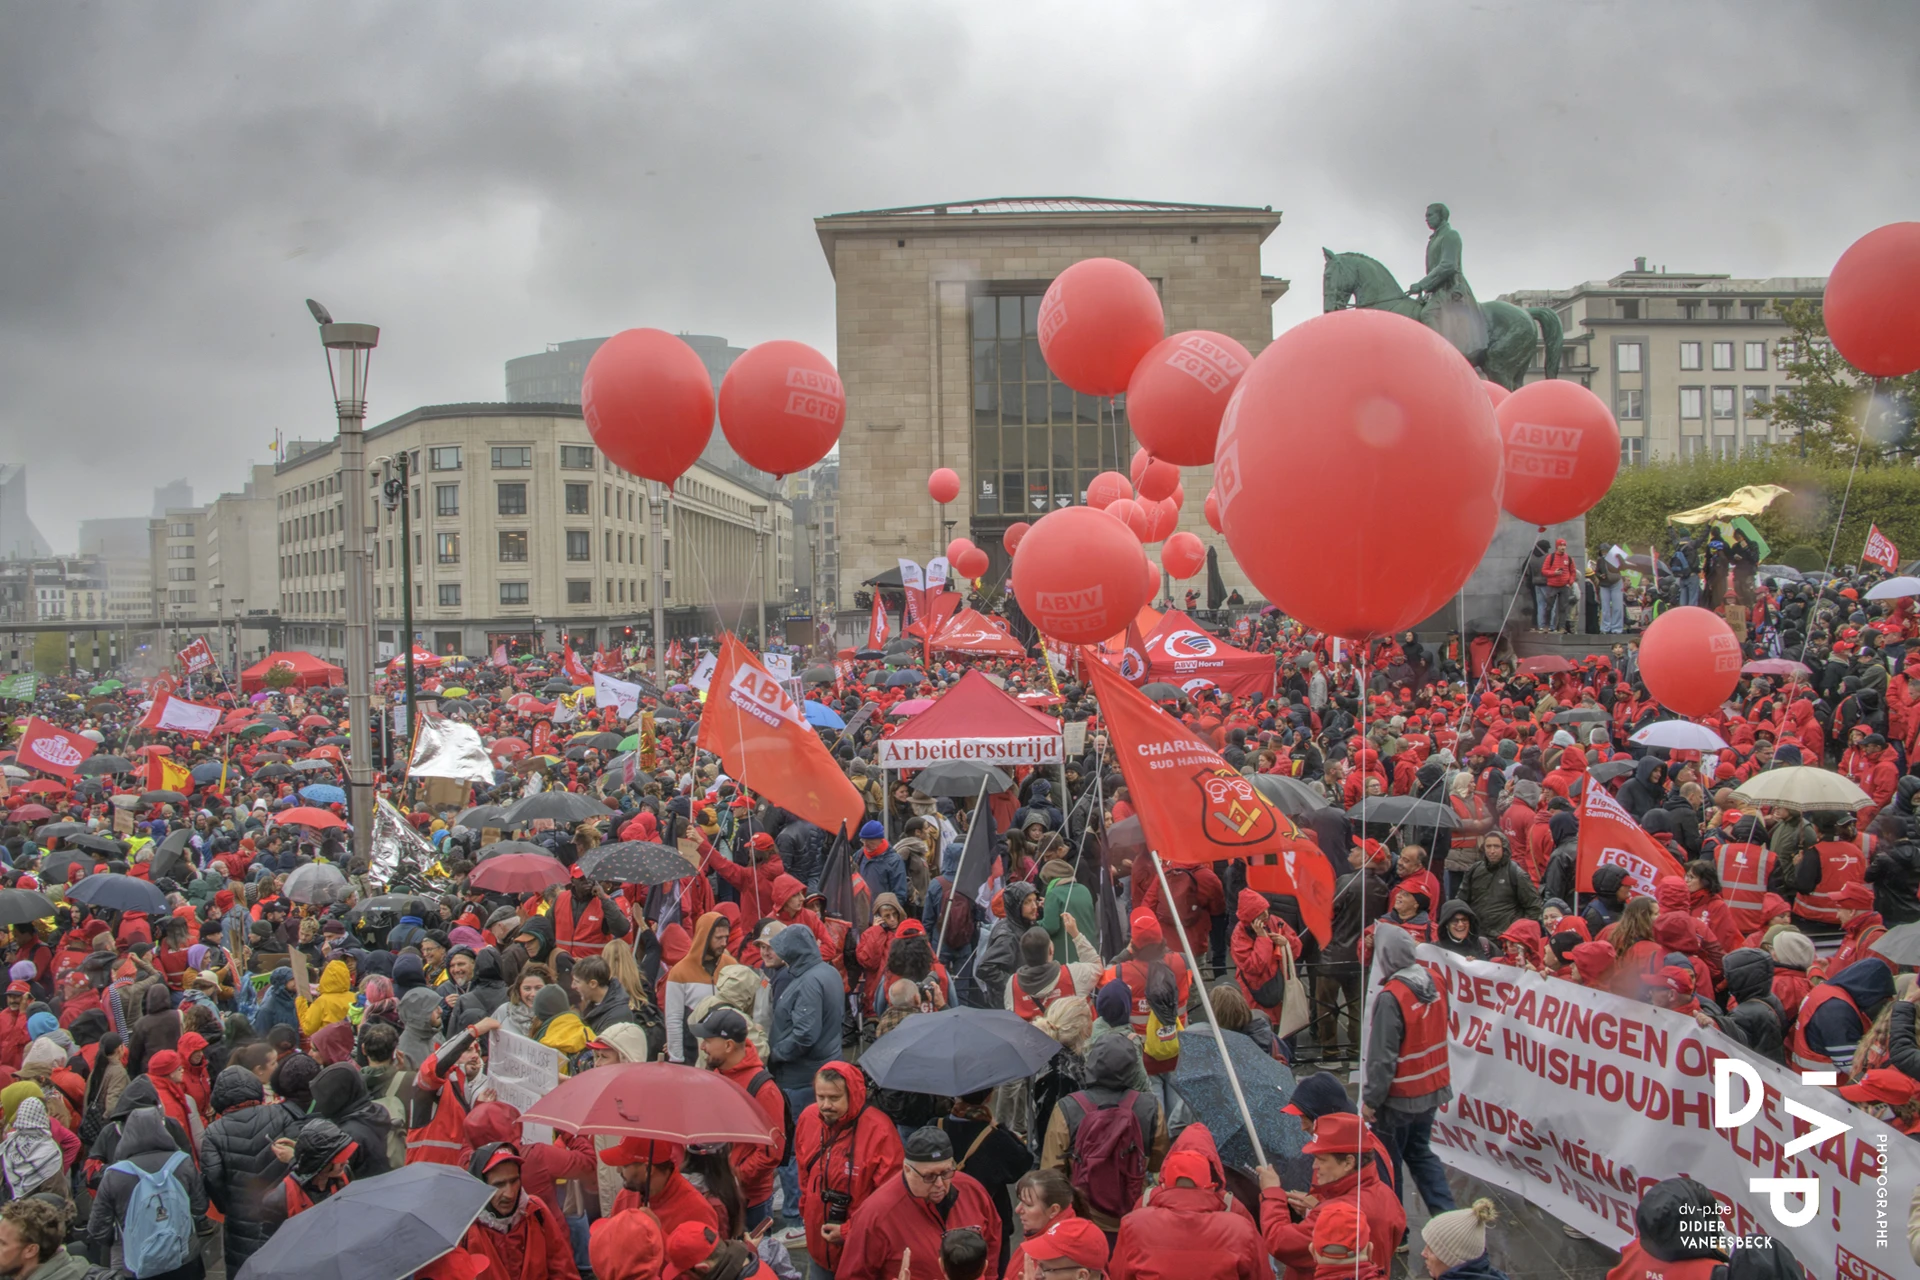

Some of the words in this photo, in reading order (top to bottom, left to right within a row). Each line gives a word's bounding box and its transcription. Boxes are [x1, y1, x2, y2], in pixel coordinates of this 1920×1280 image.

[1186, 338, 1240, 371] ABVV
[791, 370, 838, 395] ABVV
[1174, 351, 1223, 389] FGTB
[791, 396, 836, 420] FGTB
[1513, 426, 1577, 448] ABVV
[1510, 454, 1571, 476] FGTB
[1041, 590, 1099, 612] ABVV
[1045, 615, 1104, 632] FGTB
[729, 690, 780, 728] Senioren
[885, 737, 1057, 762] Arbeidersstrijd
[1150, 759, 1173, 769] SUD
[1177, 757, 1224, 767] HAINAUT
[1586, 809, 1614, 820] Samen
[1615, 816, 1635, 831] sterk
[1602, 851, 1653, 879] FGTB
[1456, 970, 1668, 1069] BESPARINGEN
[1463, 1014, 1494, 1056] DE
[1482, 1139, 1552, 1184] PAS
